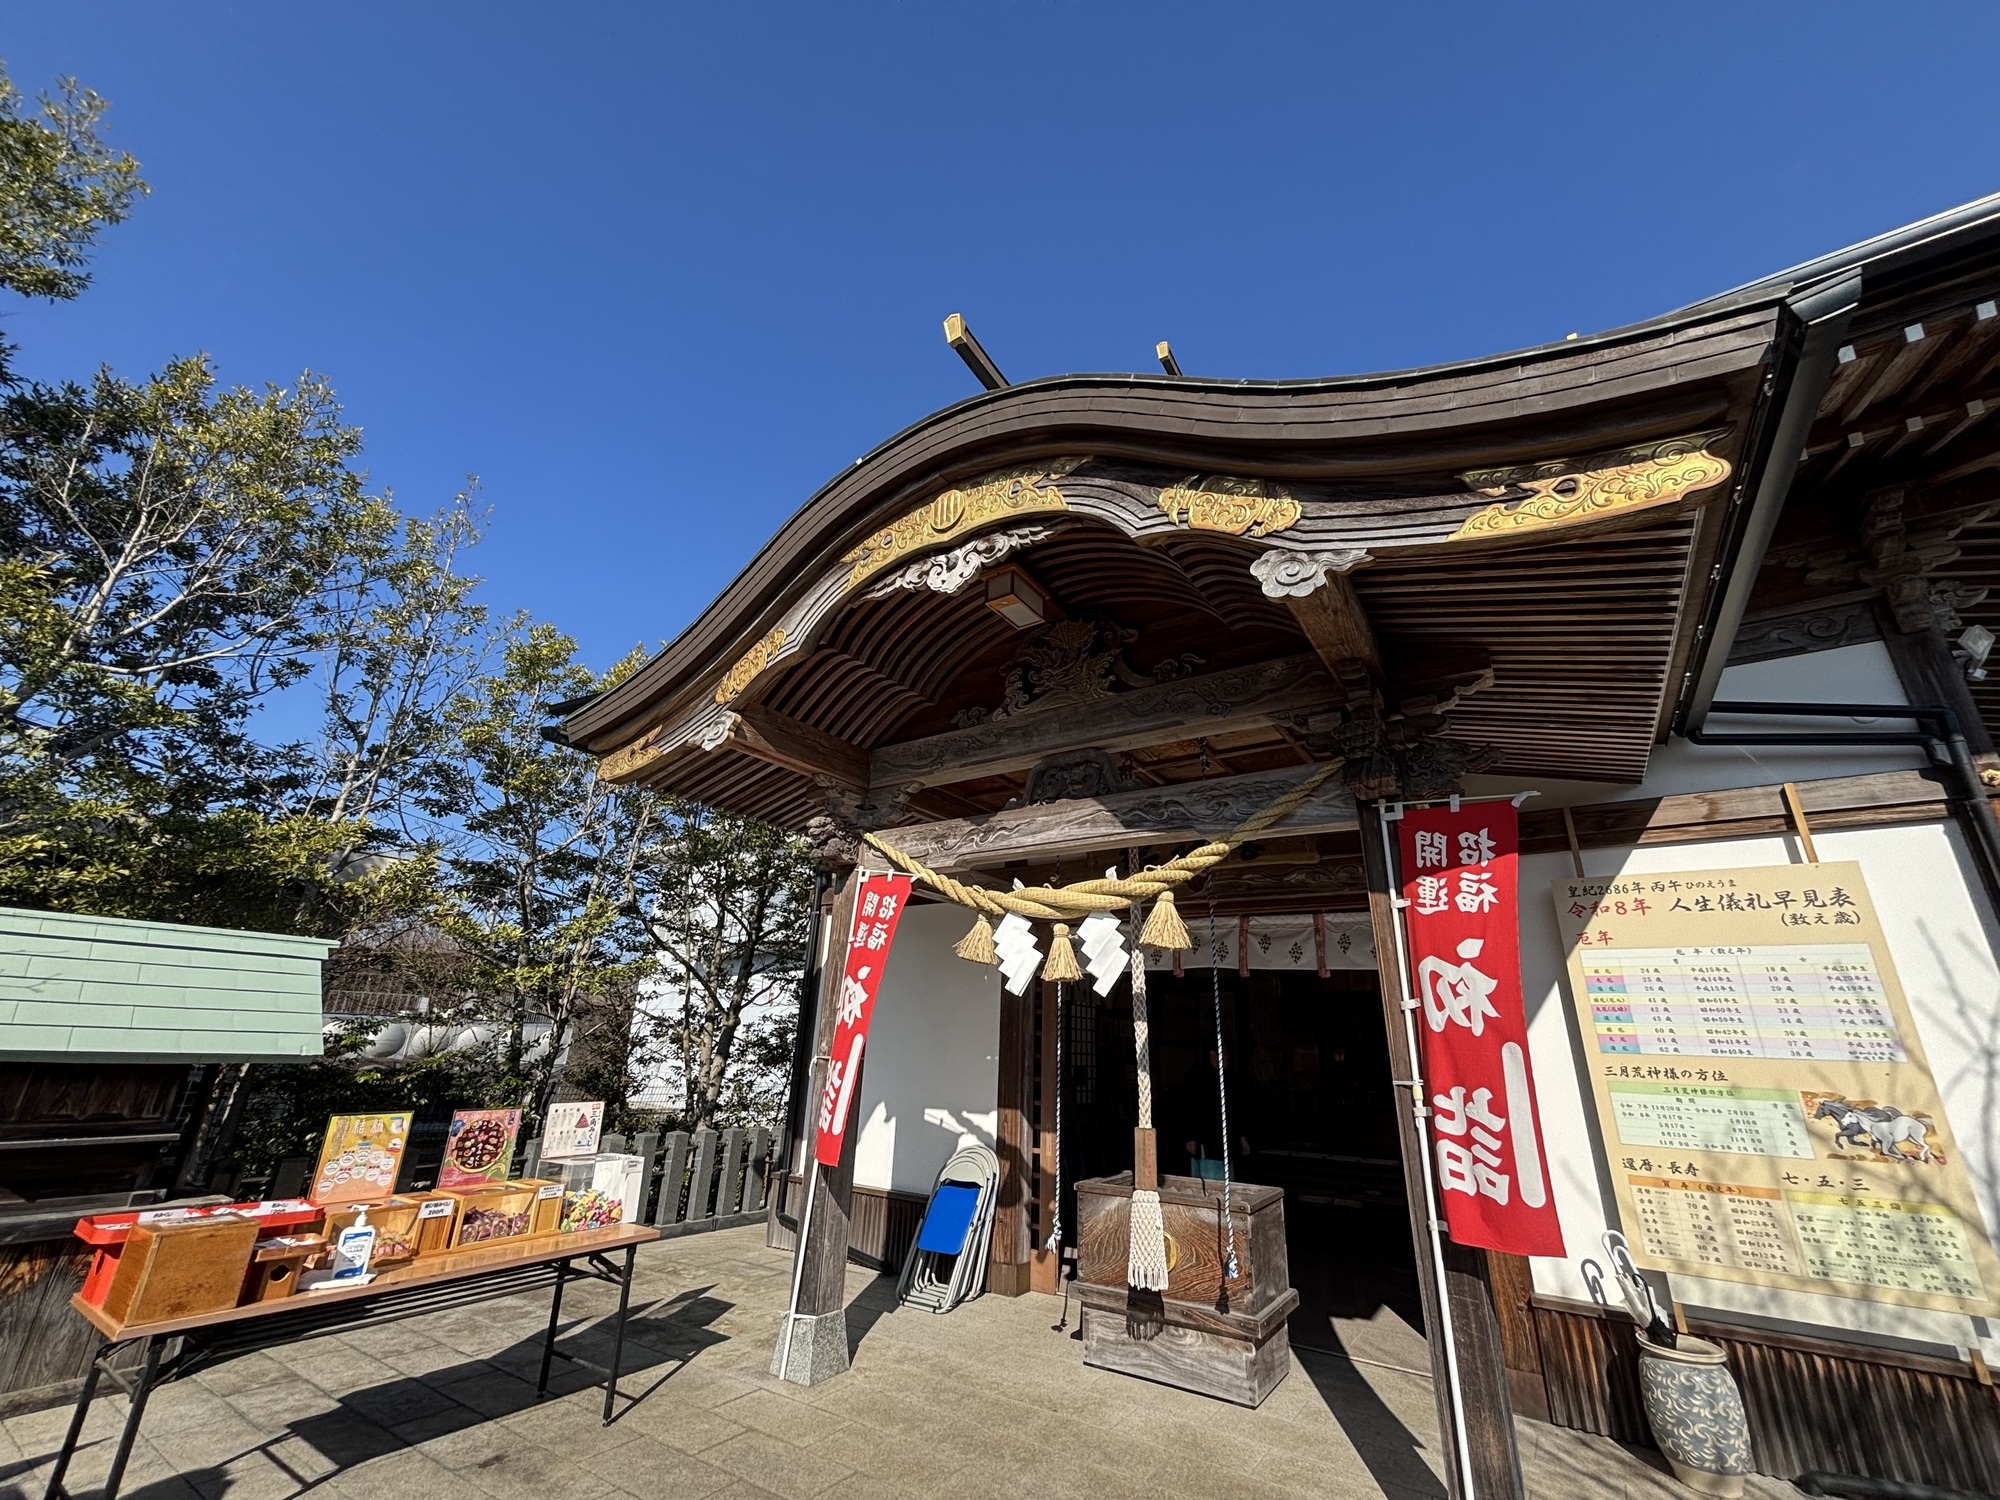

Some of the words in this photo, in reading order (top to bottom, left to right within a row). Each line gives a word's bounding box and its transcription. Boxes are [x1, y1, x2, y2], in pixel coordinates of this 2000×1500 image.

[1567, 881, 1646, 898] 皇紀2686年
[1651, 880, 1682, 893] 丙午
[1685, 879, 1737, 889] ひのえうま
[1567, 897, 1652, 918] 令和8年
[1669, 887, 1856, 912] 人生儀礼早見表
[1575, 930, 1614, 946] 厄年
[1604, 1066, 1729, 1081] 三月荒神様の方位
[1621, 1158, 1699, 1176] 還暦・長寿
[1782, 1172, 1870, 1191] 七・五・三
